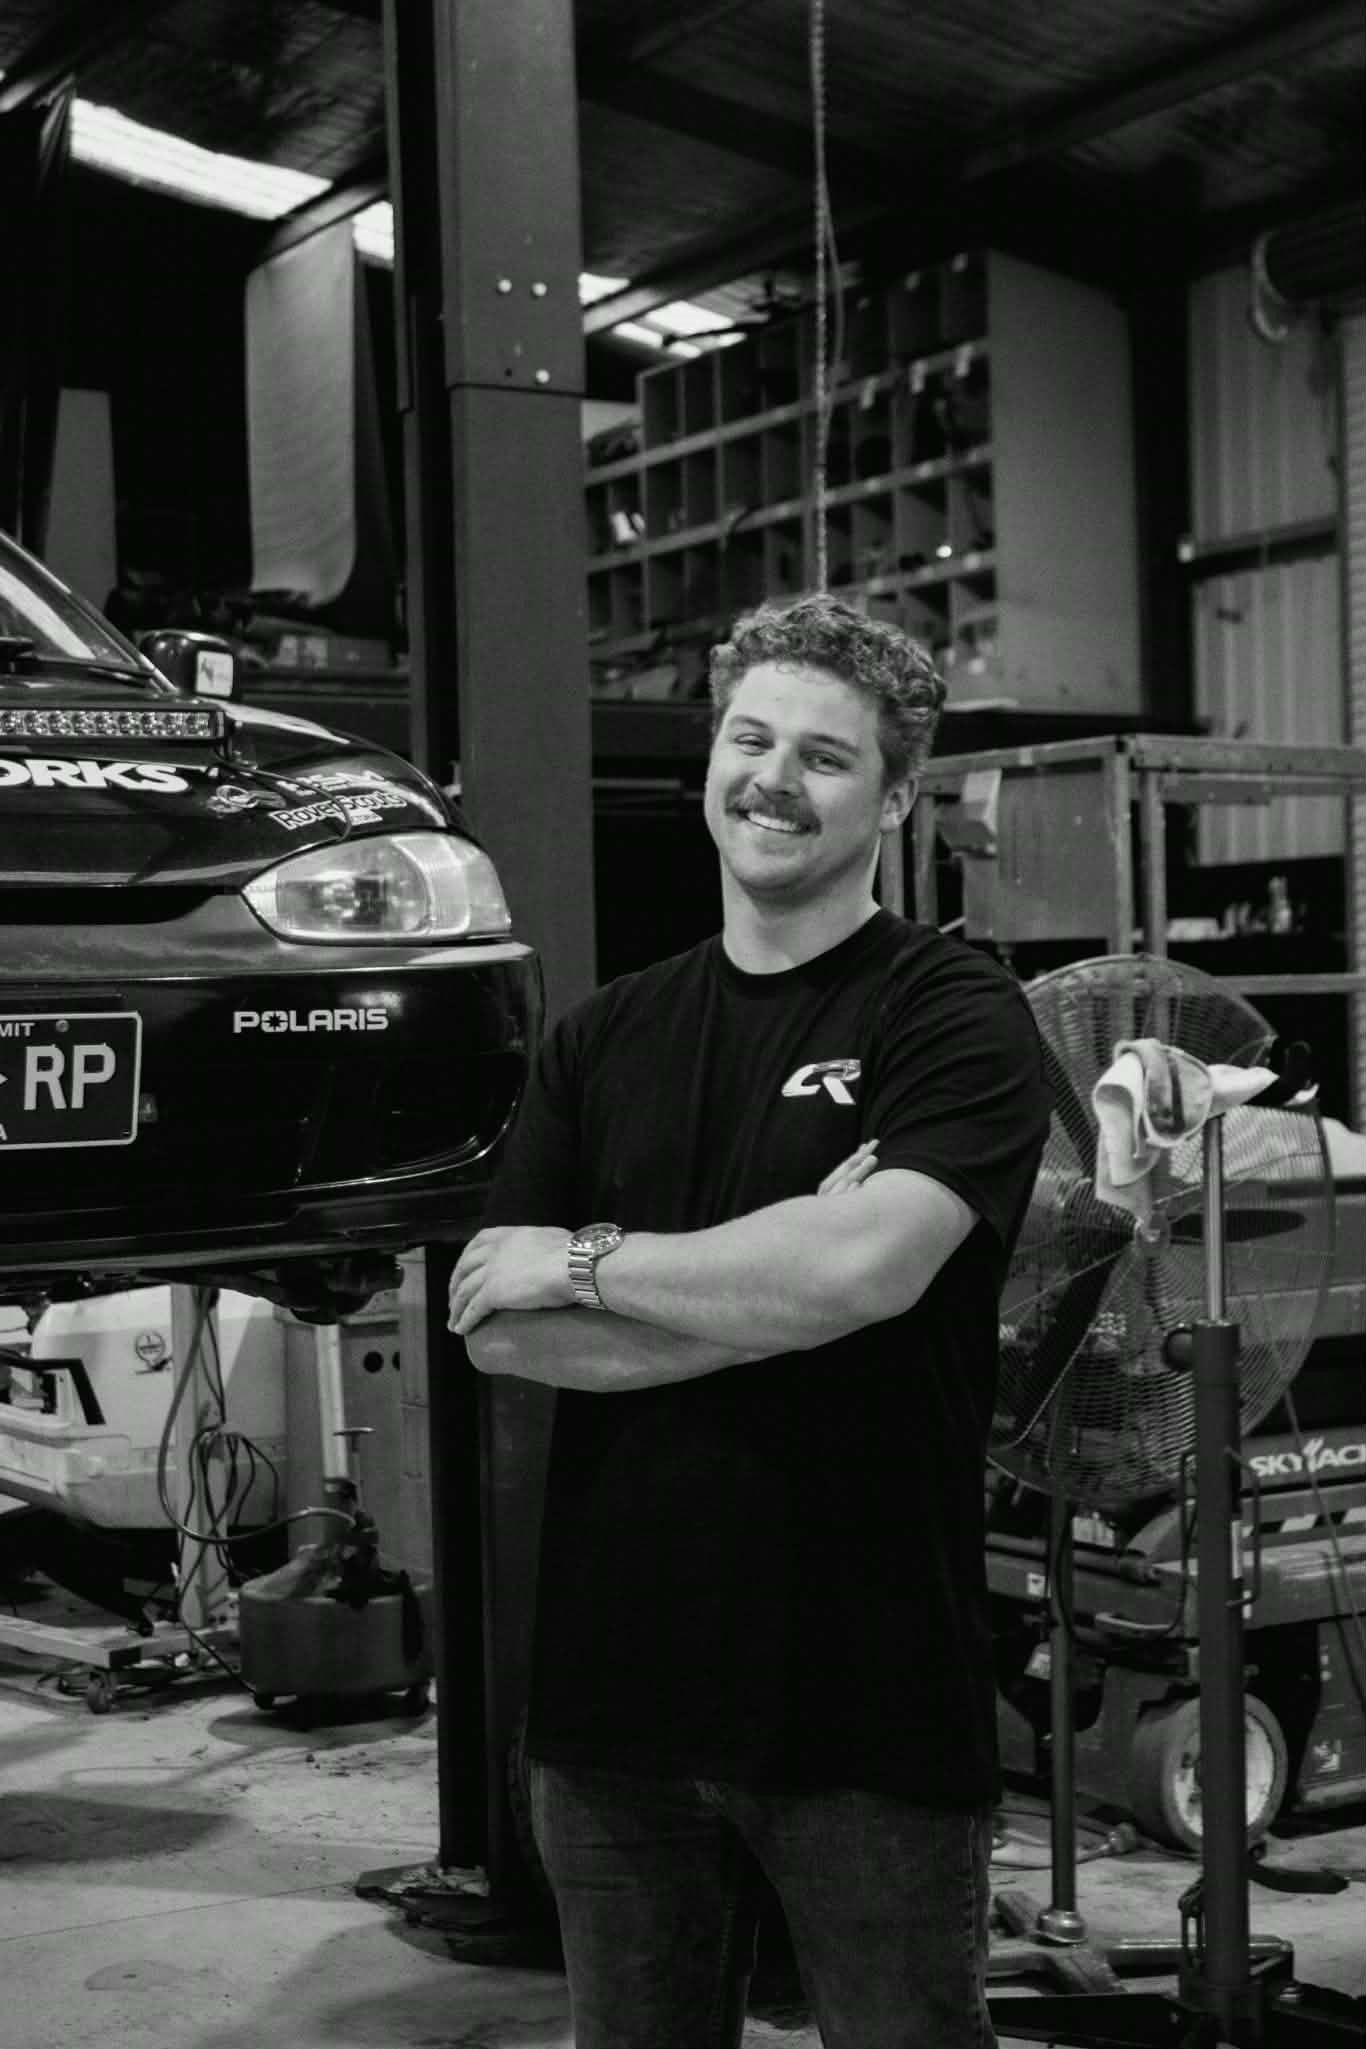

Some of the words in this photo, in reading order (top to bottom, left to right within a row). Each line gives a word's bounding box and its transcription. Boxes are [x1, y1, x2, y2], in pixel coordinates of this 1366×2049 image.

[233, 1008, 389, 1034] POLARIS
[23, 1042, 117, 1111] RP
[1248, 1436, 1366, 1477] SKYJAC
